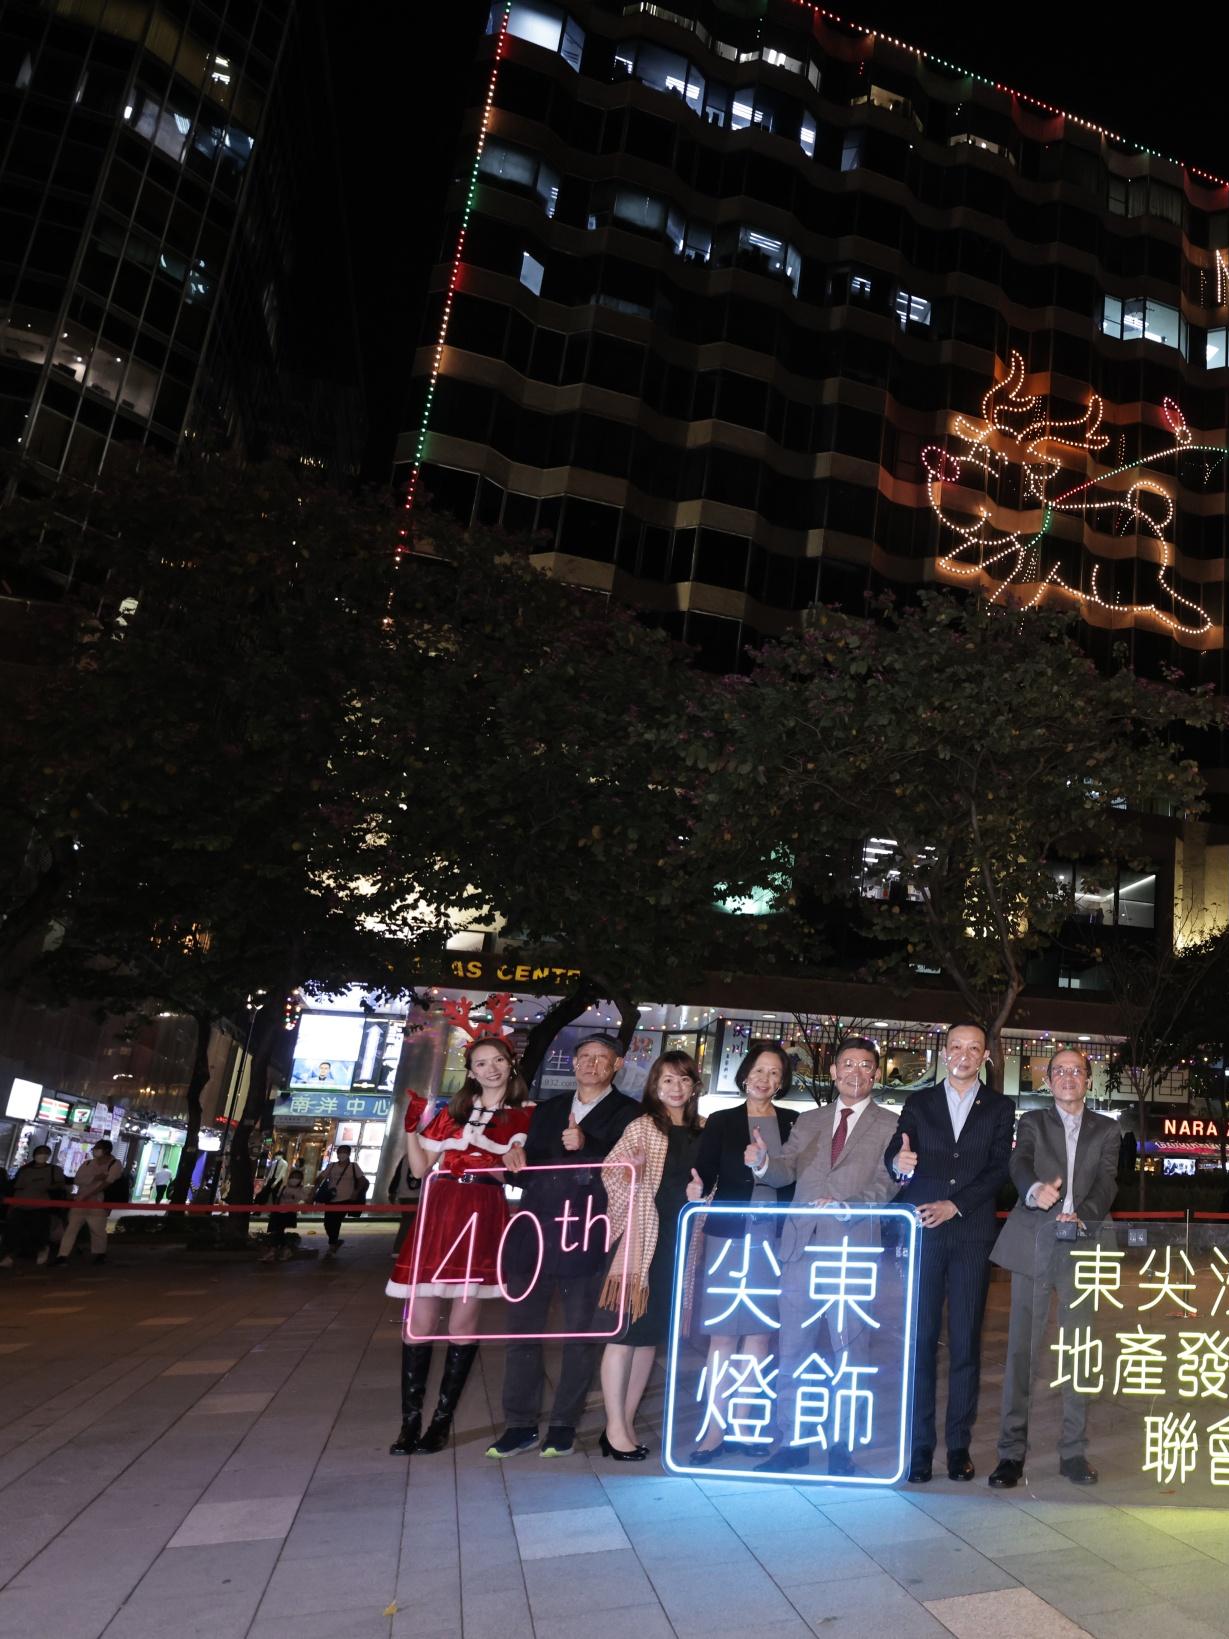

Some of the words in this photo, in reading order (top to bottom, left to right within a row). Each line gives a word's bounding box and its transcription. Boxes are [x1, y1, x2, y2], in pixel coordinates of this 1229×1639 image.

[497, 965, 582, 985] CENT
[290, 1096, 391, 1116] 南洋中心
[1164, 1119, 1218, 1136] NARA
[431, 1195, 610, 1304] 40th
[704, 1233, 885, 1333] 尖東
[695, 1350, 879, 1452] 燈飾
